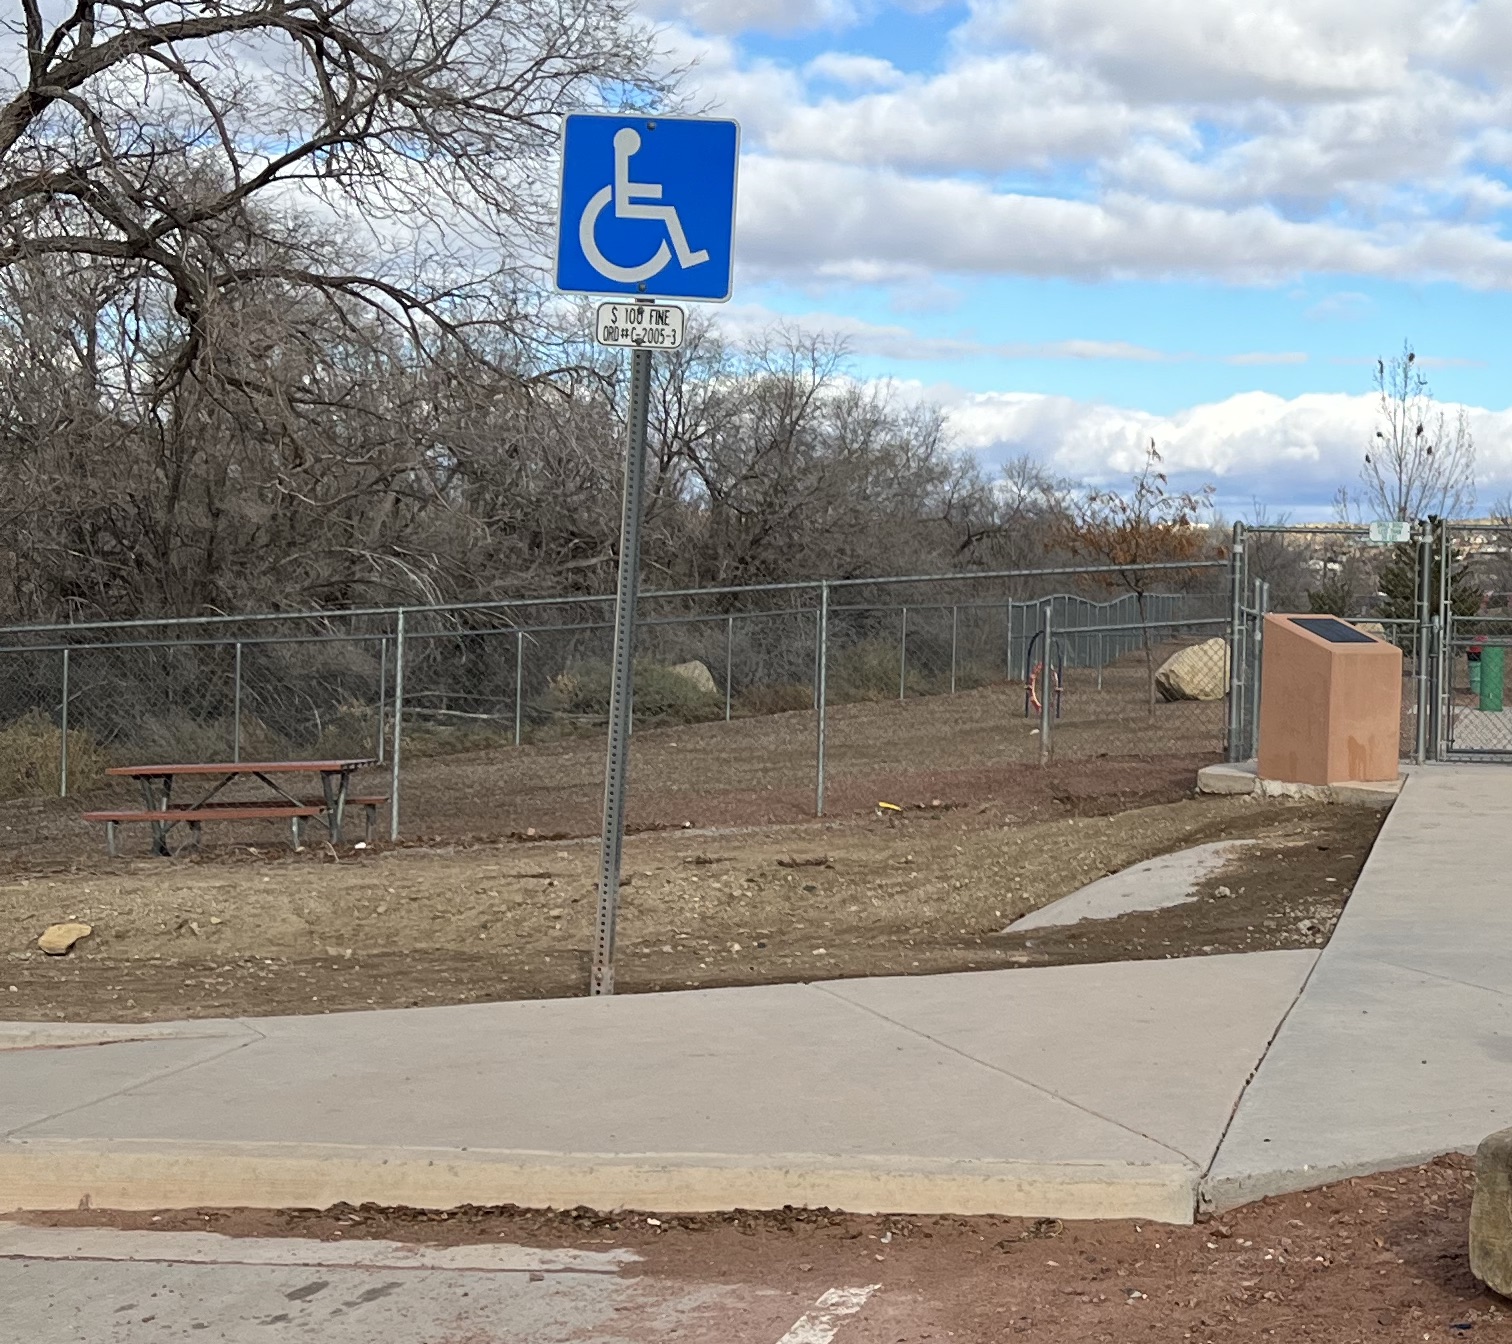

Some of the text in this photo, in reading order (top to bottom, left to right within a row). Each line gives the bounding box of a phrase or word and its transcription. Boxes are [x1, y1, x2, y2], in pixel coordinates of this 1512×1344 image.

[611, 305, 670, 326] $ 100 FINE
